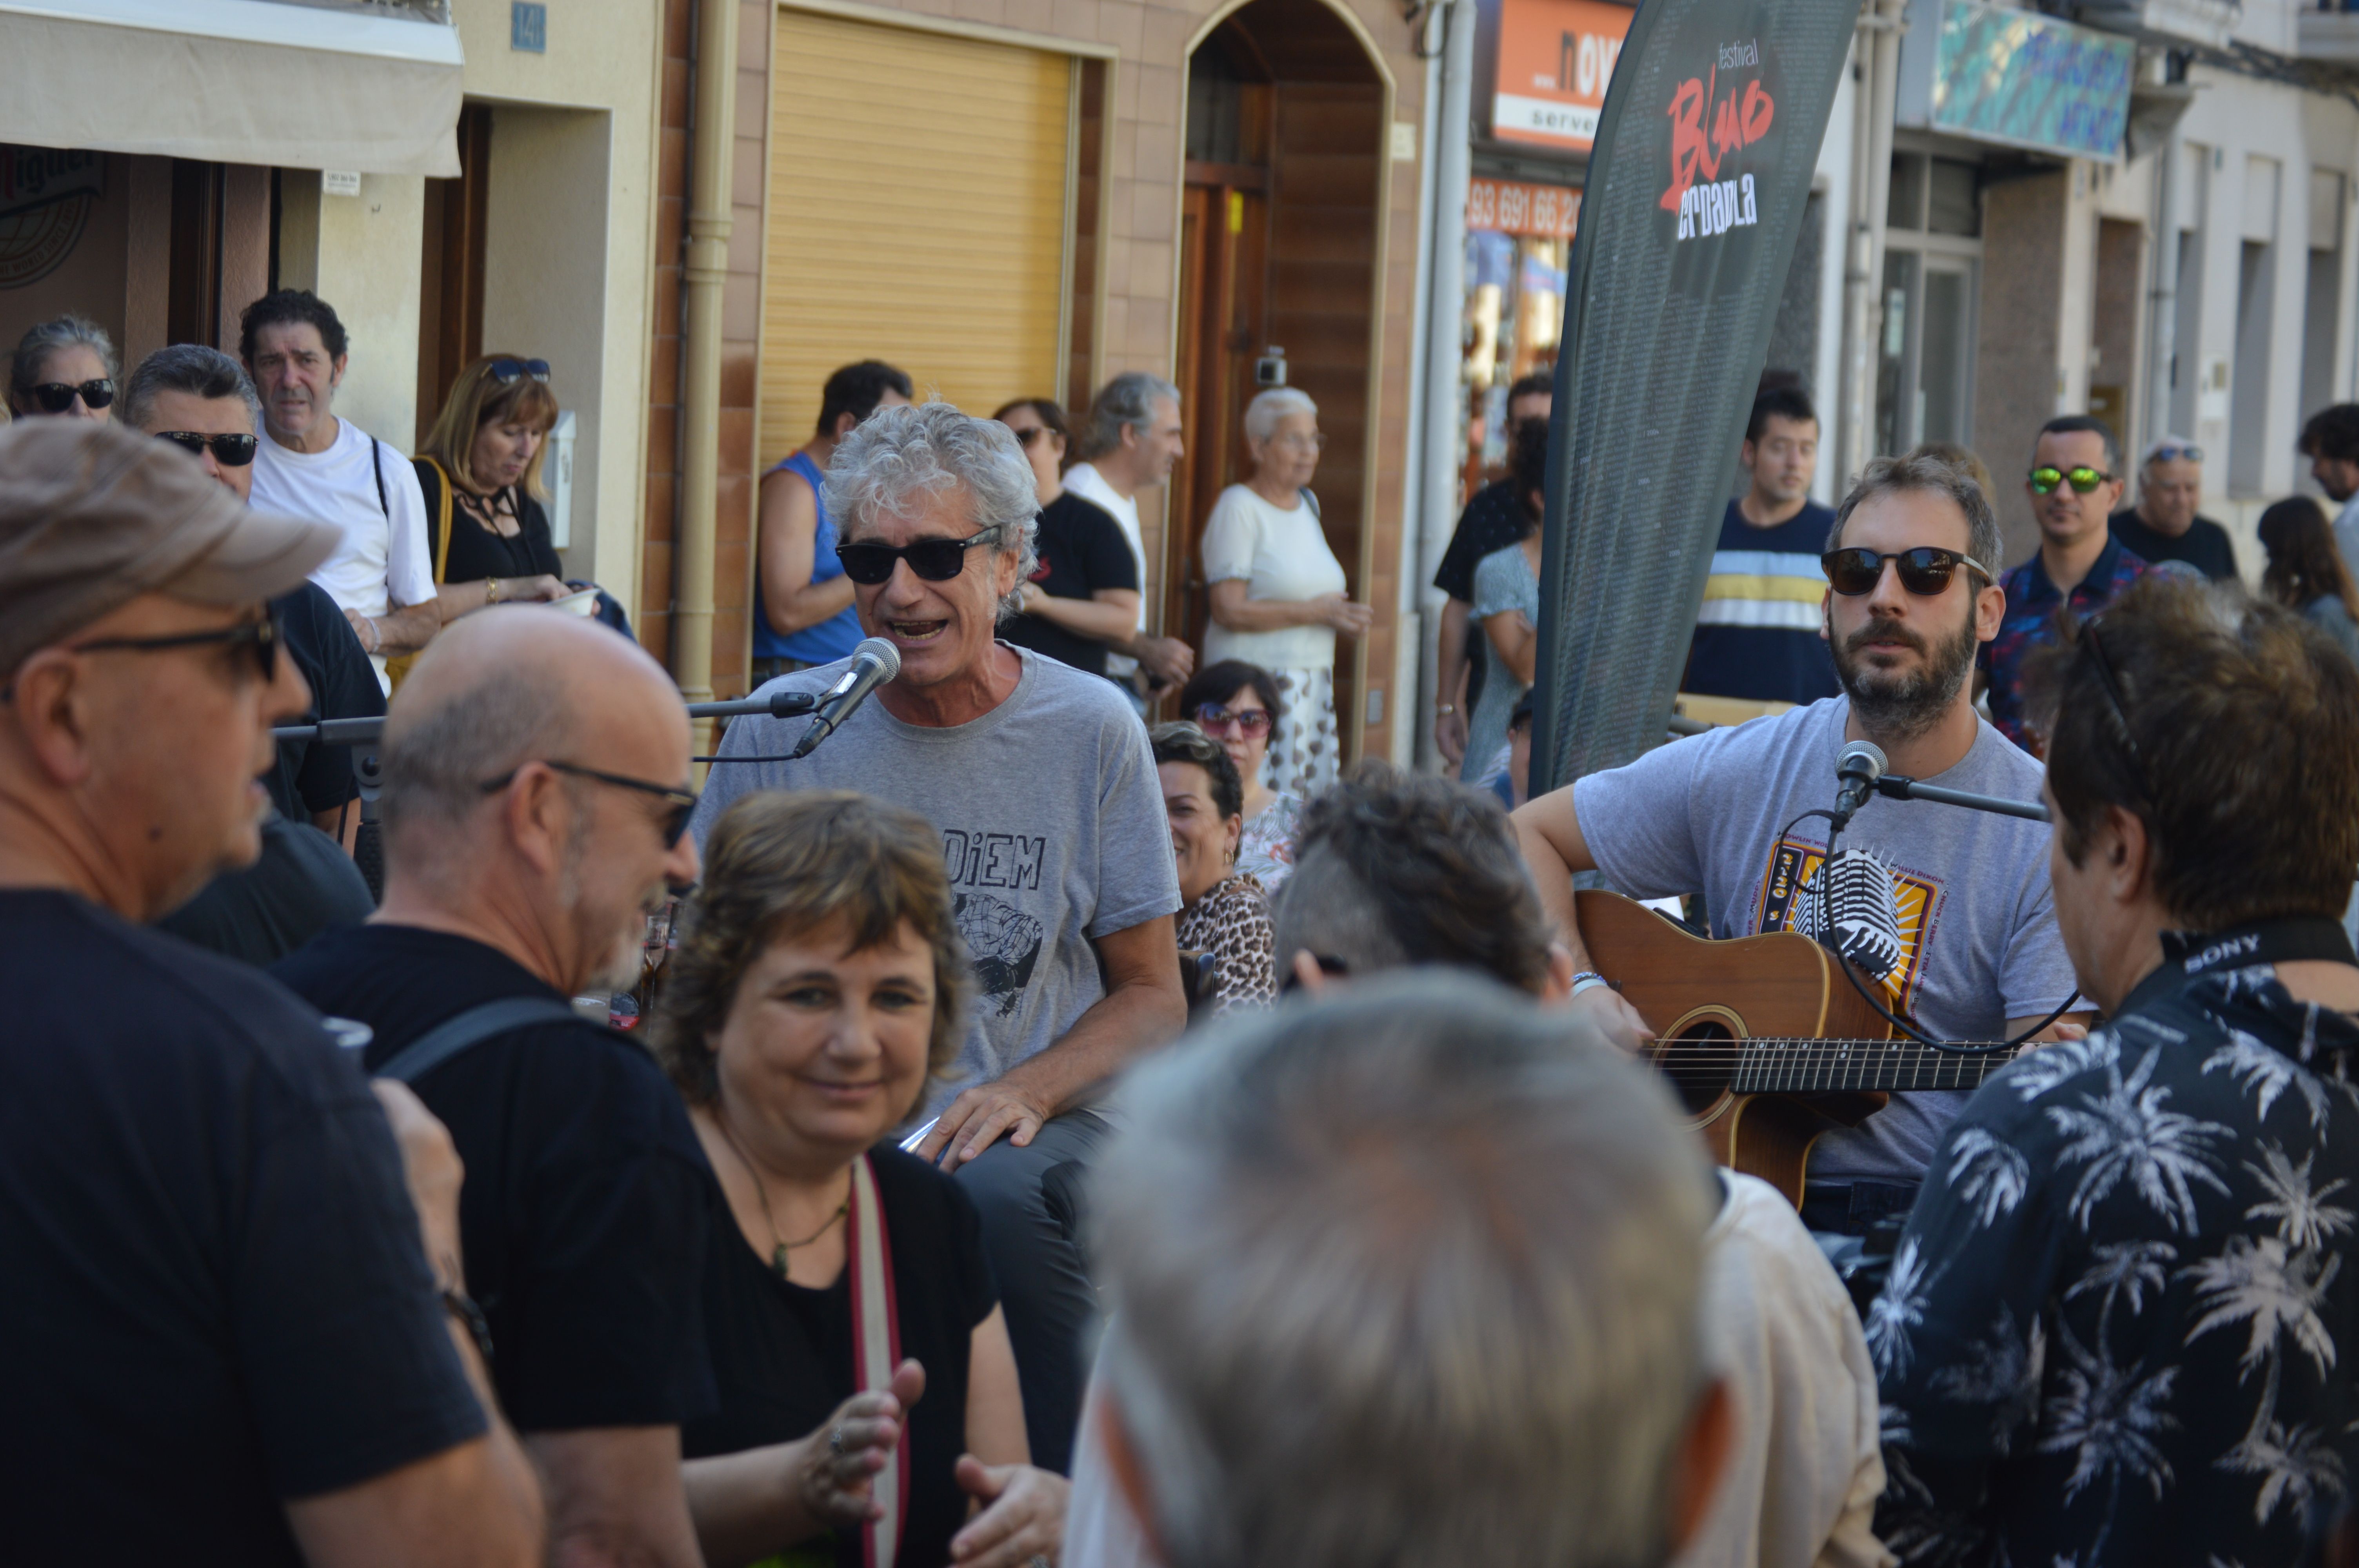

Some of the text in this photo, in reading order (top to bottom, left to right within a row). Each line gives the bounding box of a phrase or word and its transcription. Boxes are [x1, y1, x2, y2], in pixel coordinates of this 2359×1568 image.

[1719, 38, 1758, 69] festival
[1472, 182, 1496, 226] 93
[1499, 185, 1530, 231] 691
[1534, 190, 1558, 233] 66
[1917, 871, 1945, 885] DIXON
[1928, 919, 1940, 946] BERRY
[1920, 951, 1932, 973] ETTA
[2184, 933, 2261, 974] SONY
